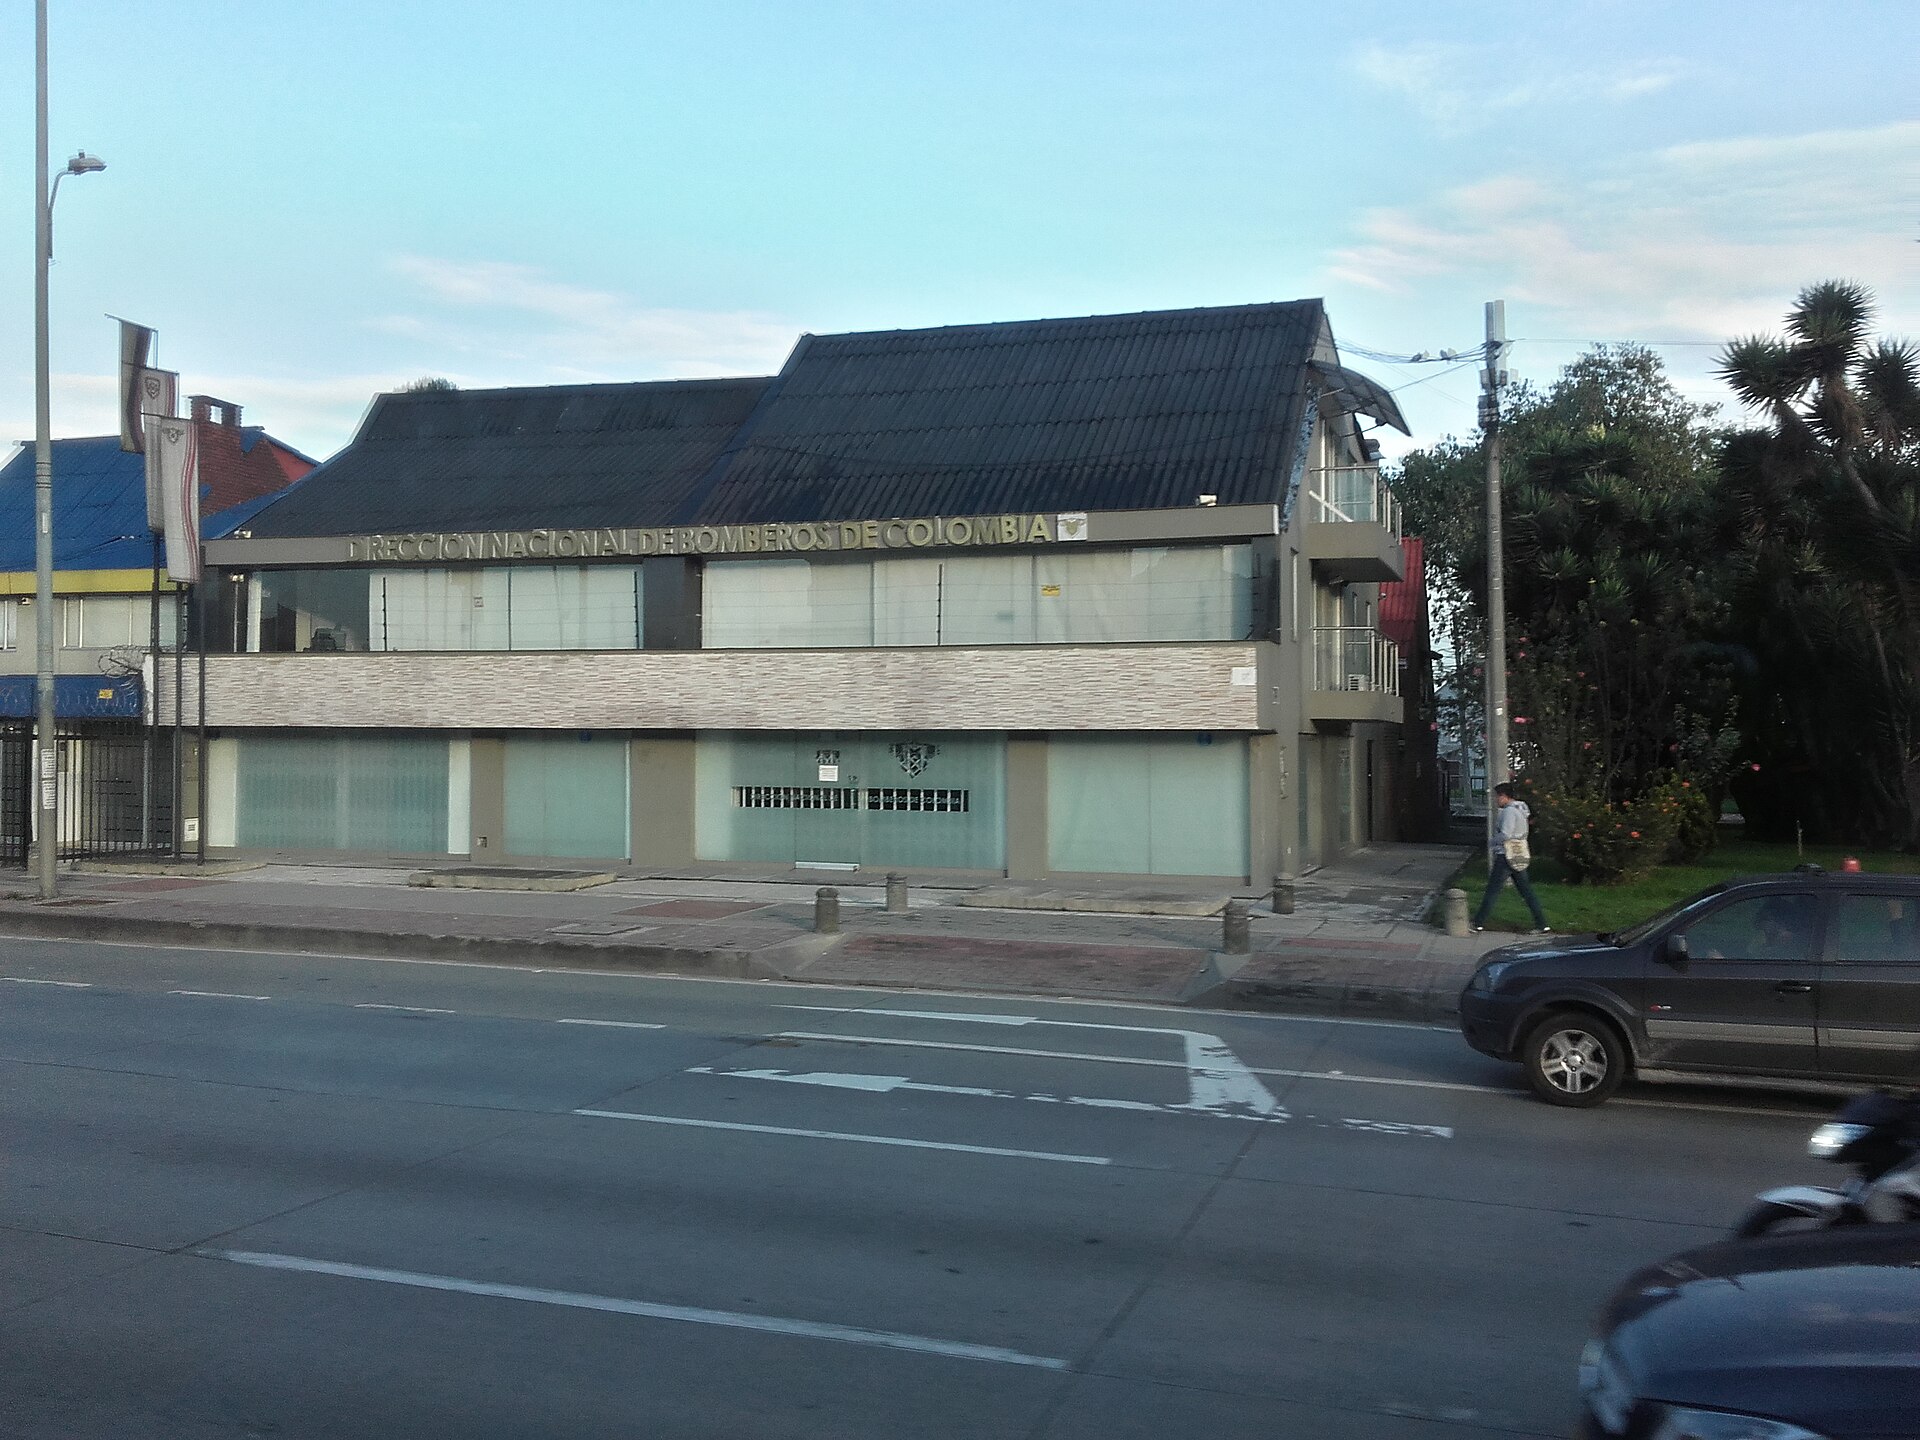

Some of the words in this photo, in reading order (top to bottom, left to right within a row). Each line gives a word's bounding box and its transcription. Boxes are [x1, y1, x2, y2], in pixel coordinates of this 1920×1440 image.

[492, 528, 633, 558] NACIONAL
[638, 527, 674, 556] DE
[677, 521, 833, 554] BOMBEROS
[840, 519, 878, 549] DE
[882, 514, 1052, 548] COLOMBIA
